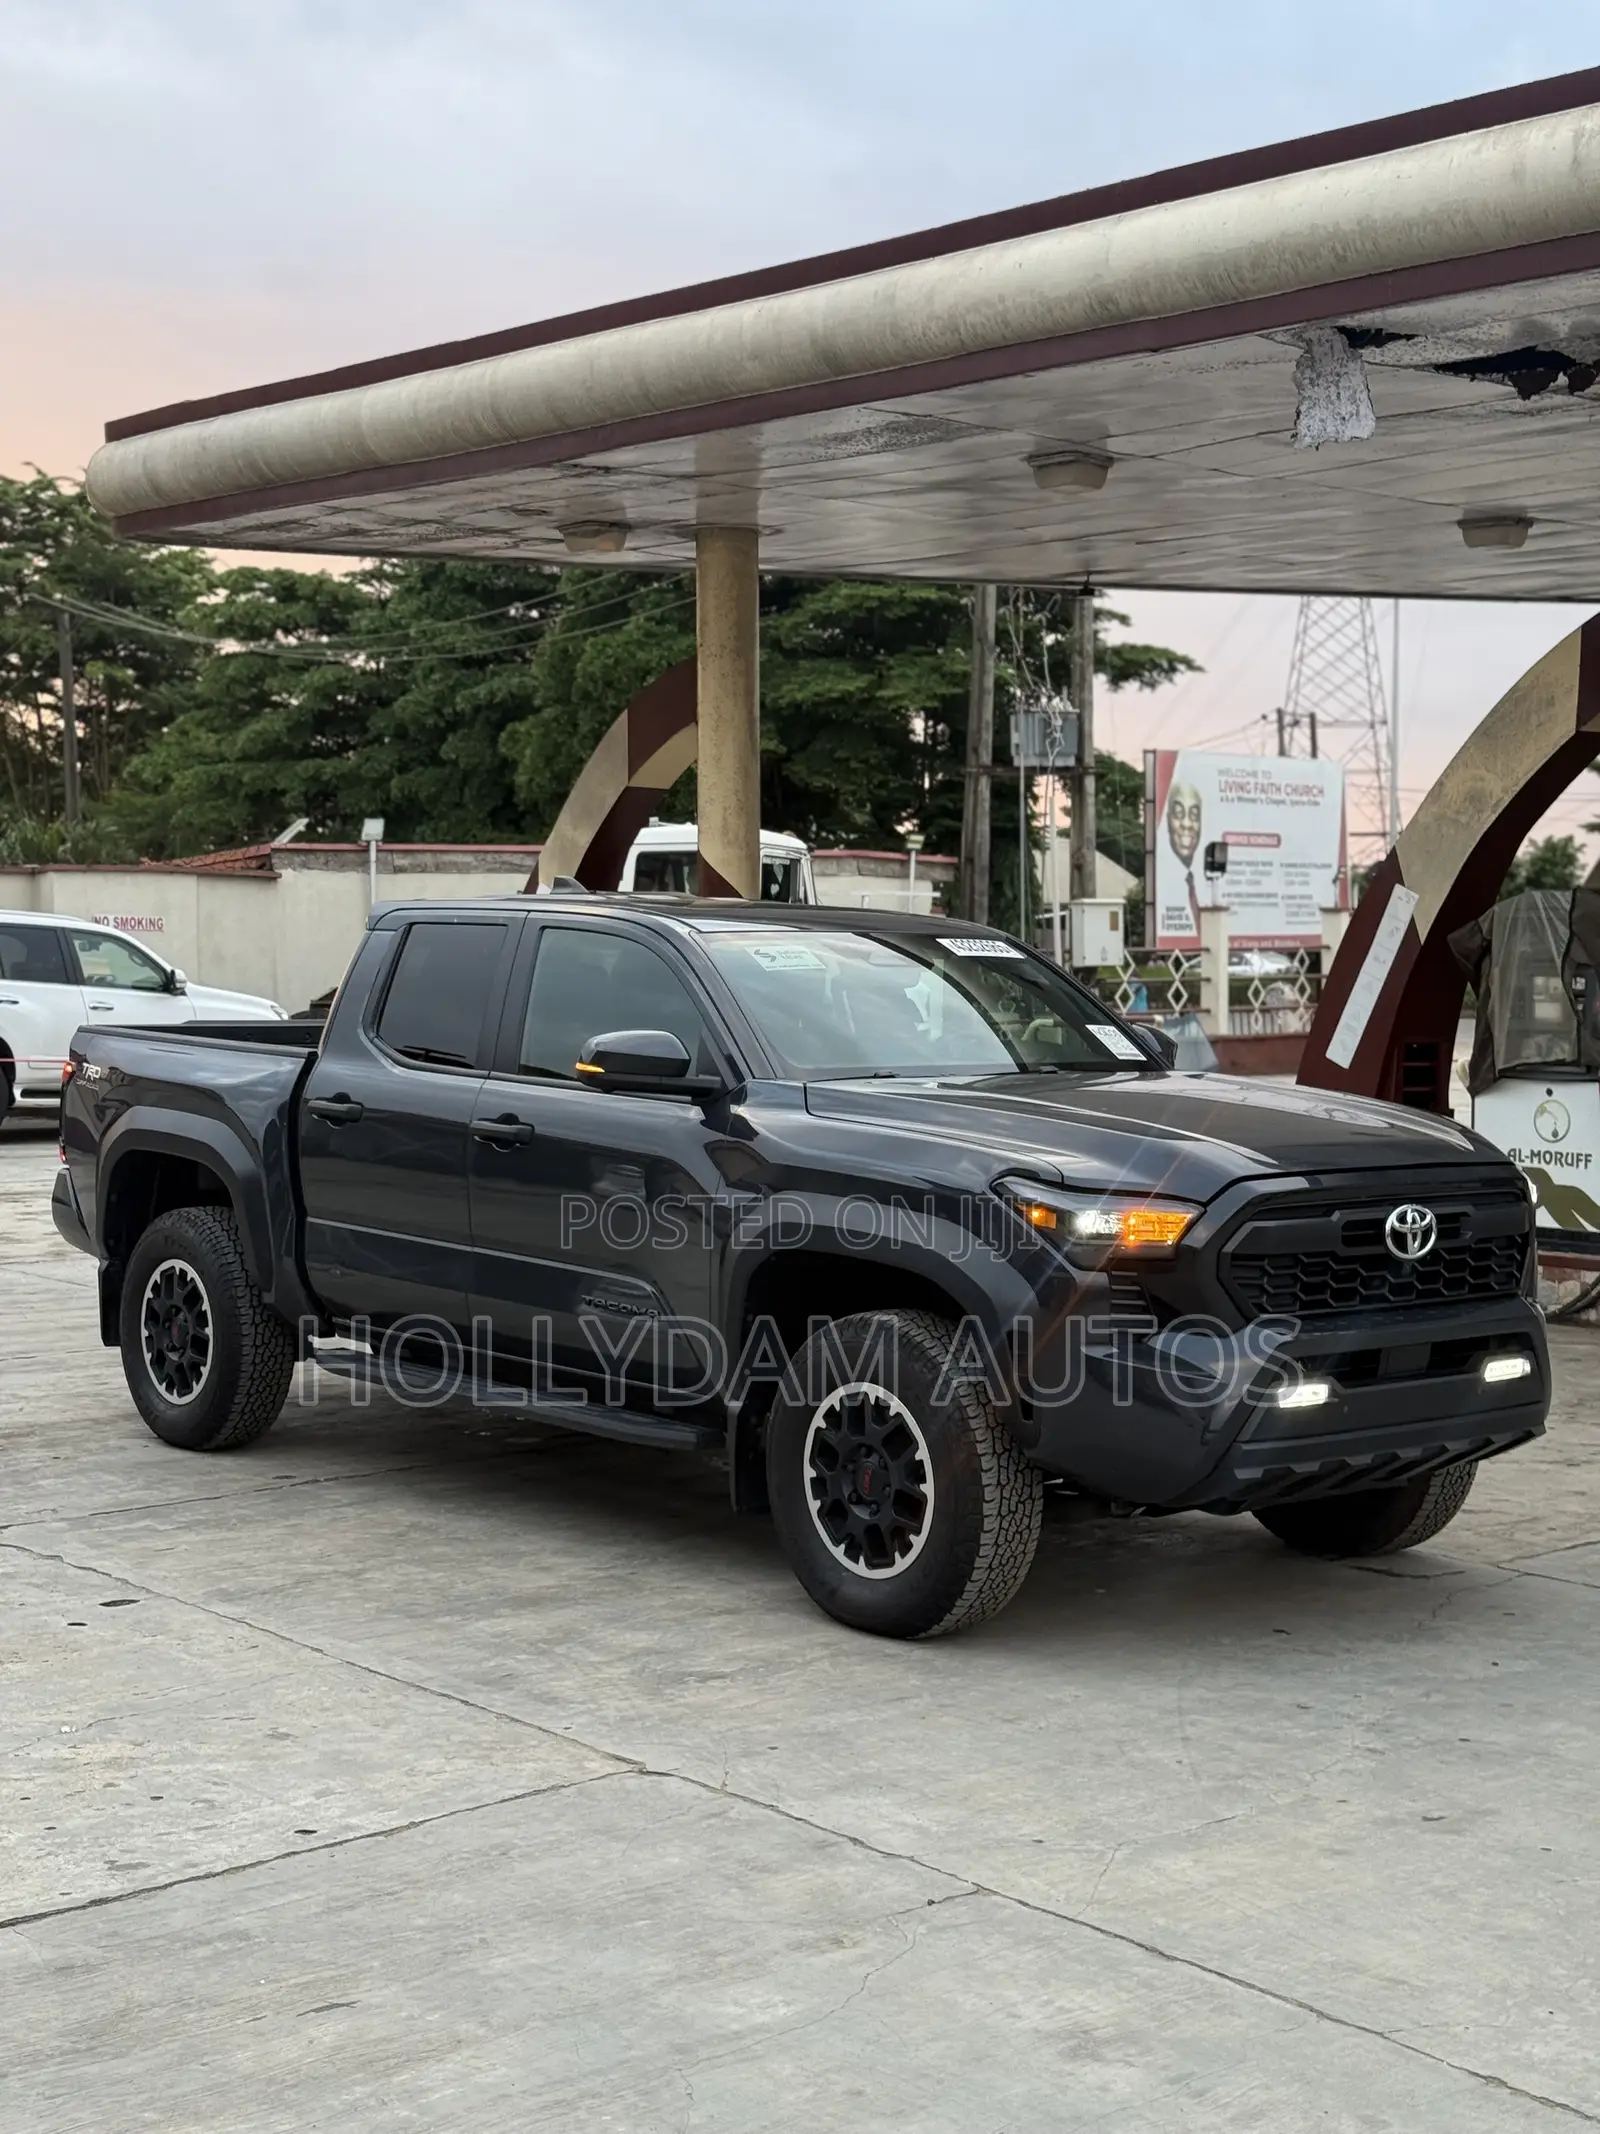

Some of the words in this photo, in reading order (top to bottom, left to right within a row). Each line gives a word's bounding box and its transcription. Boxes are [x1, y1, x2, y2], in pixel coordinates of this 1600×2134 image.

[1218, 768, 1258, 778] WELCOME
[1261, 770, 1272, 779] TO
[1219, 780, 1251, 793] LIVING
[1254, 782, 1280, 796] FAITH
[1284, 783, 1324, 798] CHURCH
[94, 916, 110, 927] NO
[113, 916, 164, 930] SMOKING
[82, 1062, 101, 1081] TRD
[1507, 1148, 1592, 1170] AL-MORUFF
